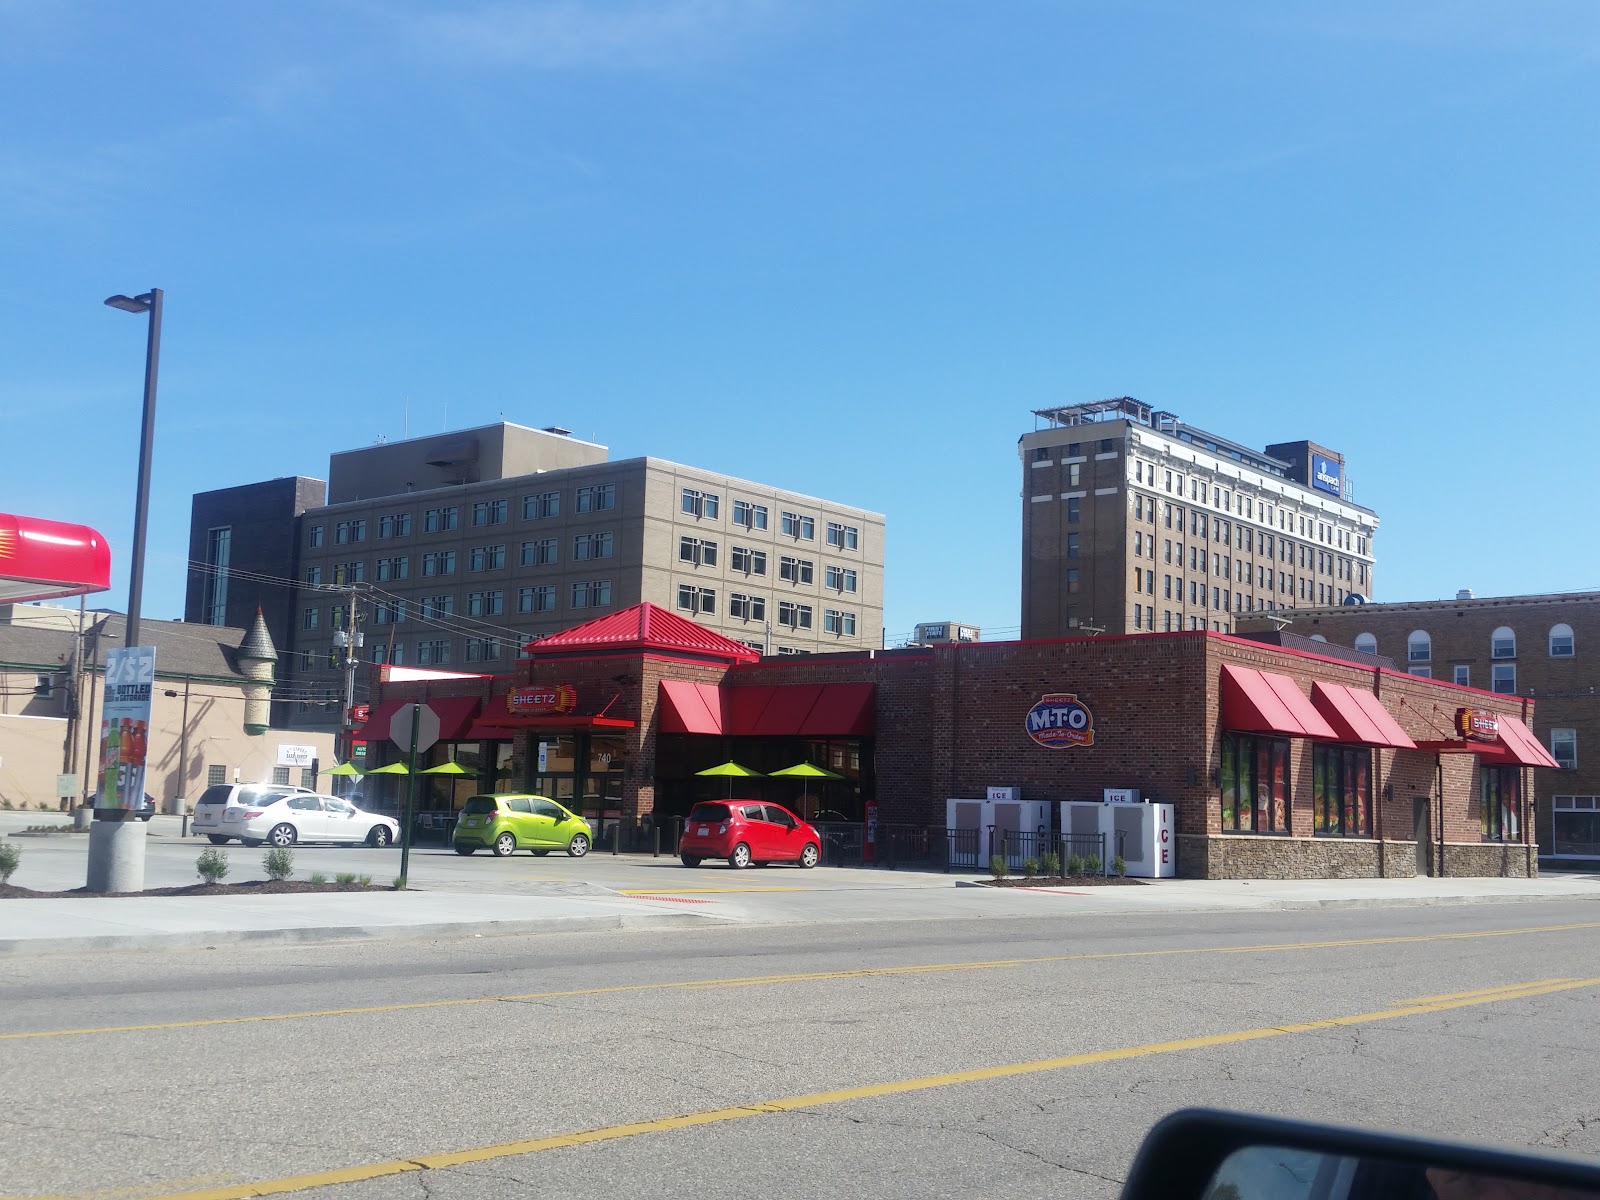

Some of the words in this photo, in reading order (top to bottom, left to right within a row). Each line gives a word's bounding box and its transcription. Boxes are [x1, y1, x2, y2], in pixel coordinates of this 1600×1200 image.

[106, 656, 152, 684] 2/$2
[117, 684, 151, 695] BOTTLED
[513, 694, 556, 705] SHEETZ
[1474, 718, 1498, 730] SHEET
[597, 753, 611, 763] 740
[1161, 809, 1169, 864] ICE
